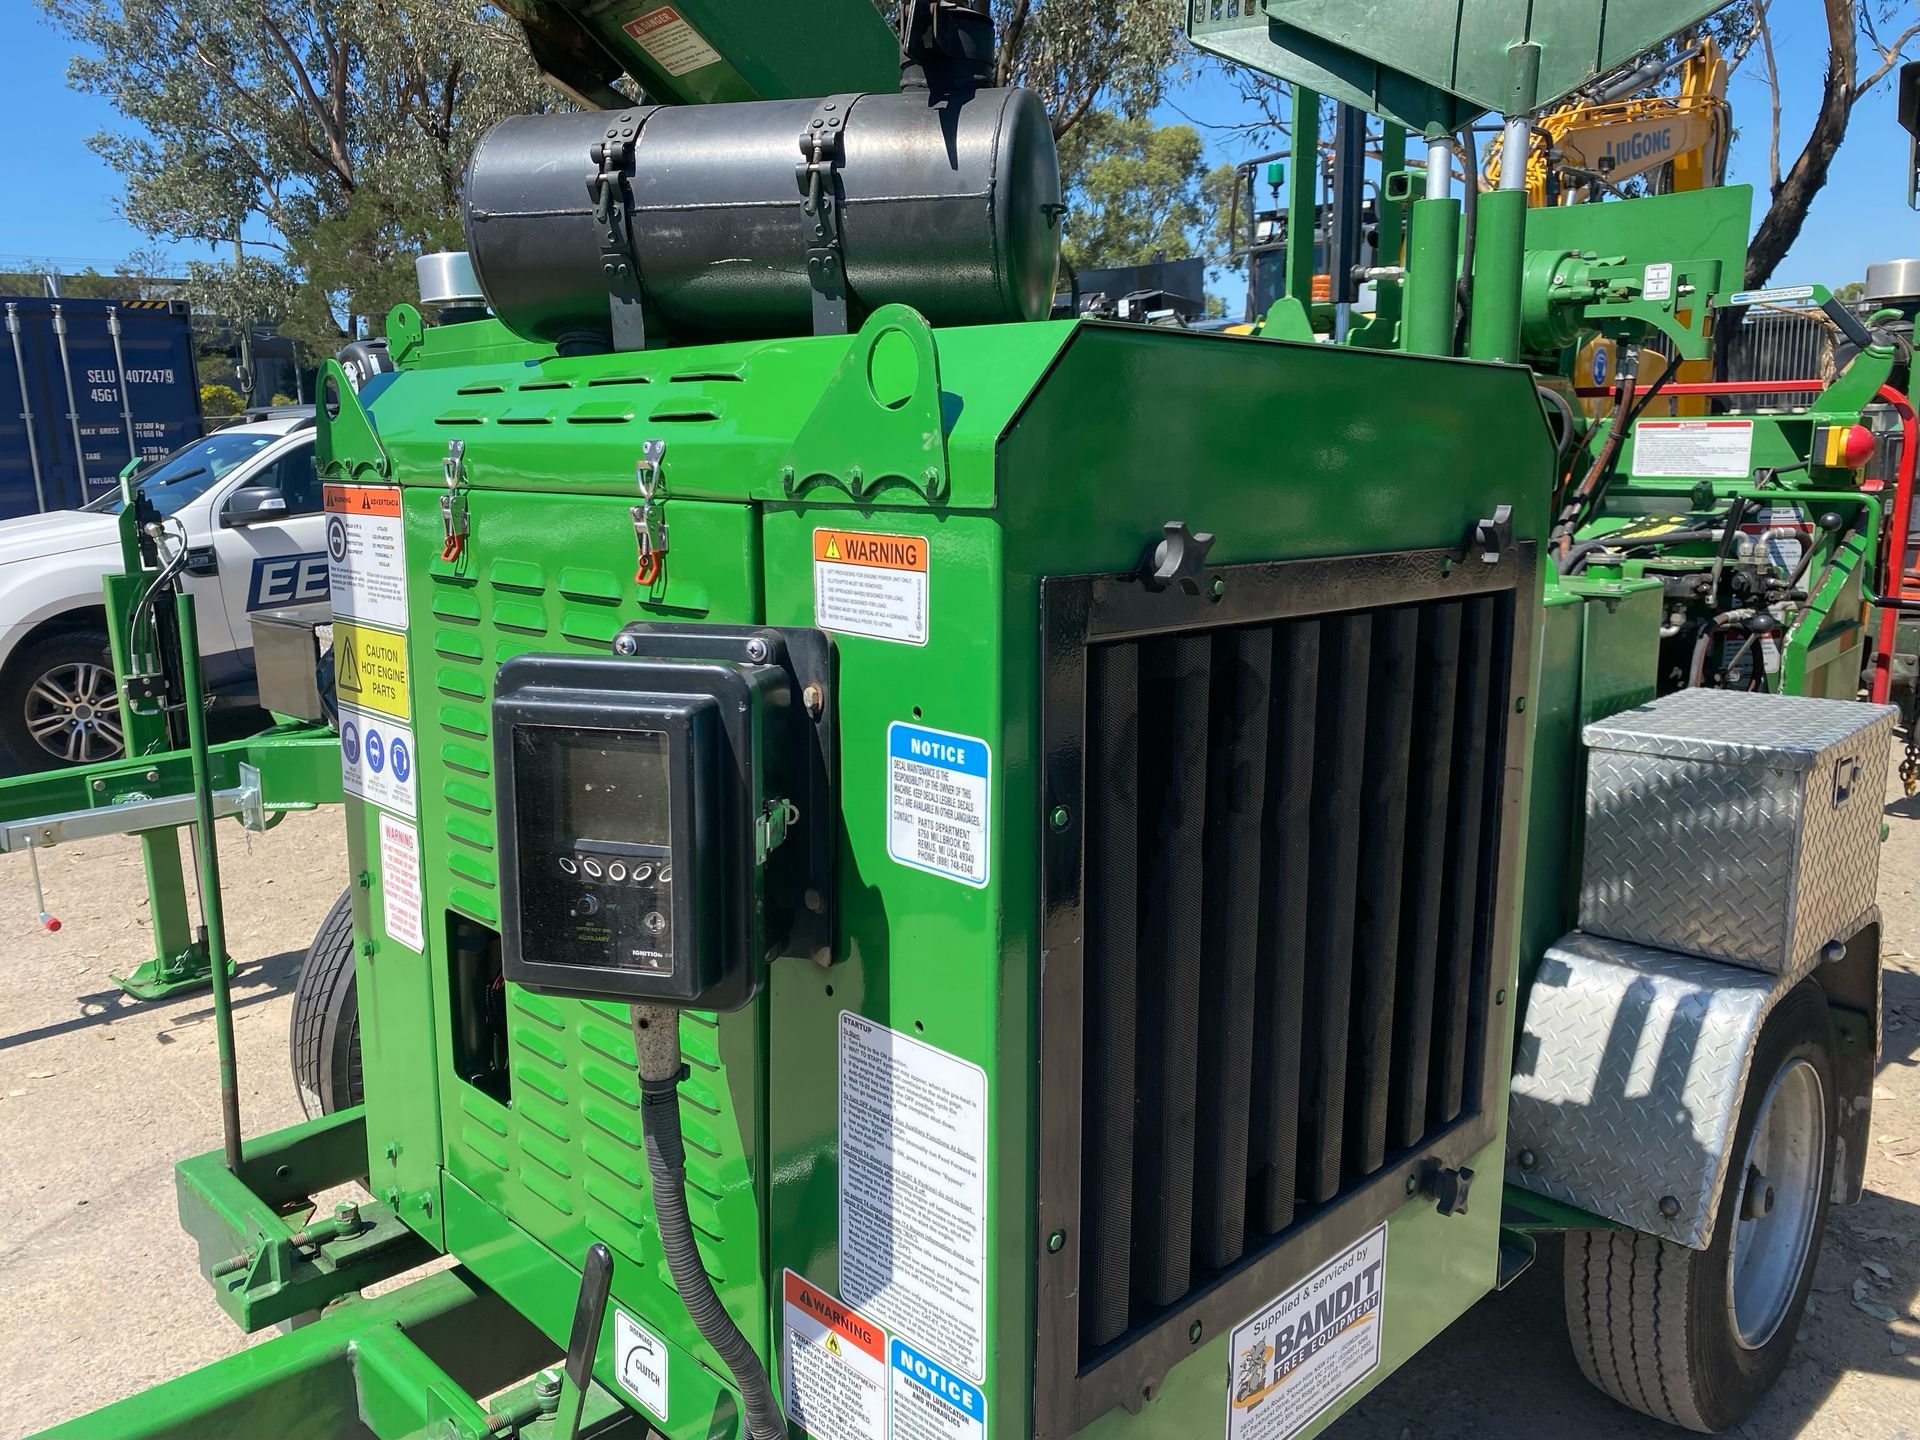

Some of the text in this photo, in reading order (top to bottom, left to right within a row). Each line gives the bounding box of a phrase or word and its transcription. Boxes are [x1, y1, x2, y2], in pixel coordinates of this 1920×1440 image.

[641, 13, 672, 30] DANGER
[87, 369, 174, 384] SELU 4072479
[91, 388, 118, 402] 45G1
[155, 423, 165, 431] kg
[370, 498, 398, 506] ADVERTENCIA
[845, 539, 916, 566] WARNING
[365, 643, 397, 662] CAUTION
[361, 661, 405, 683] HOT ENGINE
[372, 682, 395, 699] PARTS
[910, 737, 965, 765] NOTICE
[894, 759, 905, 771] DECAL
[907, 762, 934, 778] MAINTENANCE
[894, 771, 923, 787] RESPONSIBILITY
[924, 778, 929, 789] OF
[939, 782, 954, 795] OWNER
[955, 786, 960, 796] OF
[962, 787, 971, 799] THIS
[912, 787, 922, 799] KEEP
[923, 790, 938, 803] DECALS
[957, 798, 973, 812] DECALS
[913, 799, 933, 814] AVAILABLE
[934, 805, 939, 815] IN
[940, 806, 953, 819] OTHER
[384, 824, 413, 849] WARNING
[917, 816, 933, 830] PARTS
[935, 821, 969, 840] DEPARTMENT
[917, 838, 974, 864] REMUS, MI USA 49340
[930, 831, 960, 849] MILLBROOK
[962, 840, 971, 852] RD.
[917, 849, 934, 863] PHONE
[632, 950, 662, 958] IGNITION
[843, 1016, 871, 1035] STARTUP
[1254, 1248, 1368, 1337] Supplied & serviced by
[814, 1298, 871, 1345] WARNING
[1273, 1257, 1380, 1366] BANDIT
[629, 1324, 652, 1348] DISENGAGE
[1275, 1348, 1304, 1381] TREE
[1311, 1292, 1377, 1355] EQUIPMENT
[635, 1357, 659, 1386] CLUTCH
[791, 1329, 876, 1392] OPERATION OF THIS EQUIPMENT
[791, 1355, 801, 1368] DRY
[791, 1338, 861, 1391] MAY CREATE SPARKS THAT
[622, 1374, 638, 1393] ENGAGE
[791, 1347, 861, 1400] CAN START FIRES AROUND
[791, 1364, 818, 1389] ARRESTER
[820, 1384, 830, 1398] MAY
[832, 1392, 839, 1404] BE
[900, 1348, 972, 1410] NOTICE
[791, 1373, 801, 1385] THE
[802, 1380, 831, 1406] OPERATOR
[791, 1381, 815, 1404] CONTACT
[816, 1399, 834, 1417] LOCAL
[904, 1376, 930, 1400] MAINTAIN
[932, 1394, 968, 1425] LUBRICATION
[791, 1390, 801, 1403] FOR
[803, 1398, 817, 1414] LAWS
[819, 1409, 826, 1421] OR
[791, 1398, 816, 1422] RELATING
[818, 1417, 825, 1428] TO
[912, 1390, 923, 1404] AND
[925, 1399, 960, 1428] HYDRAULICS
